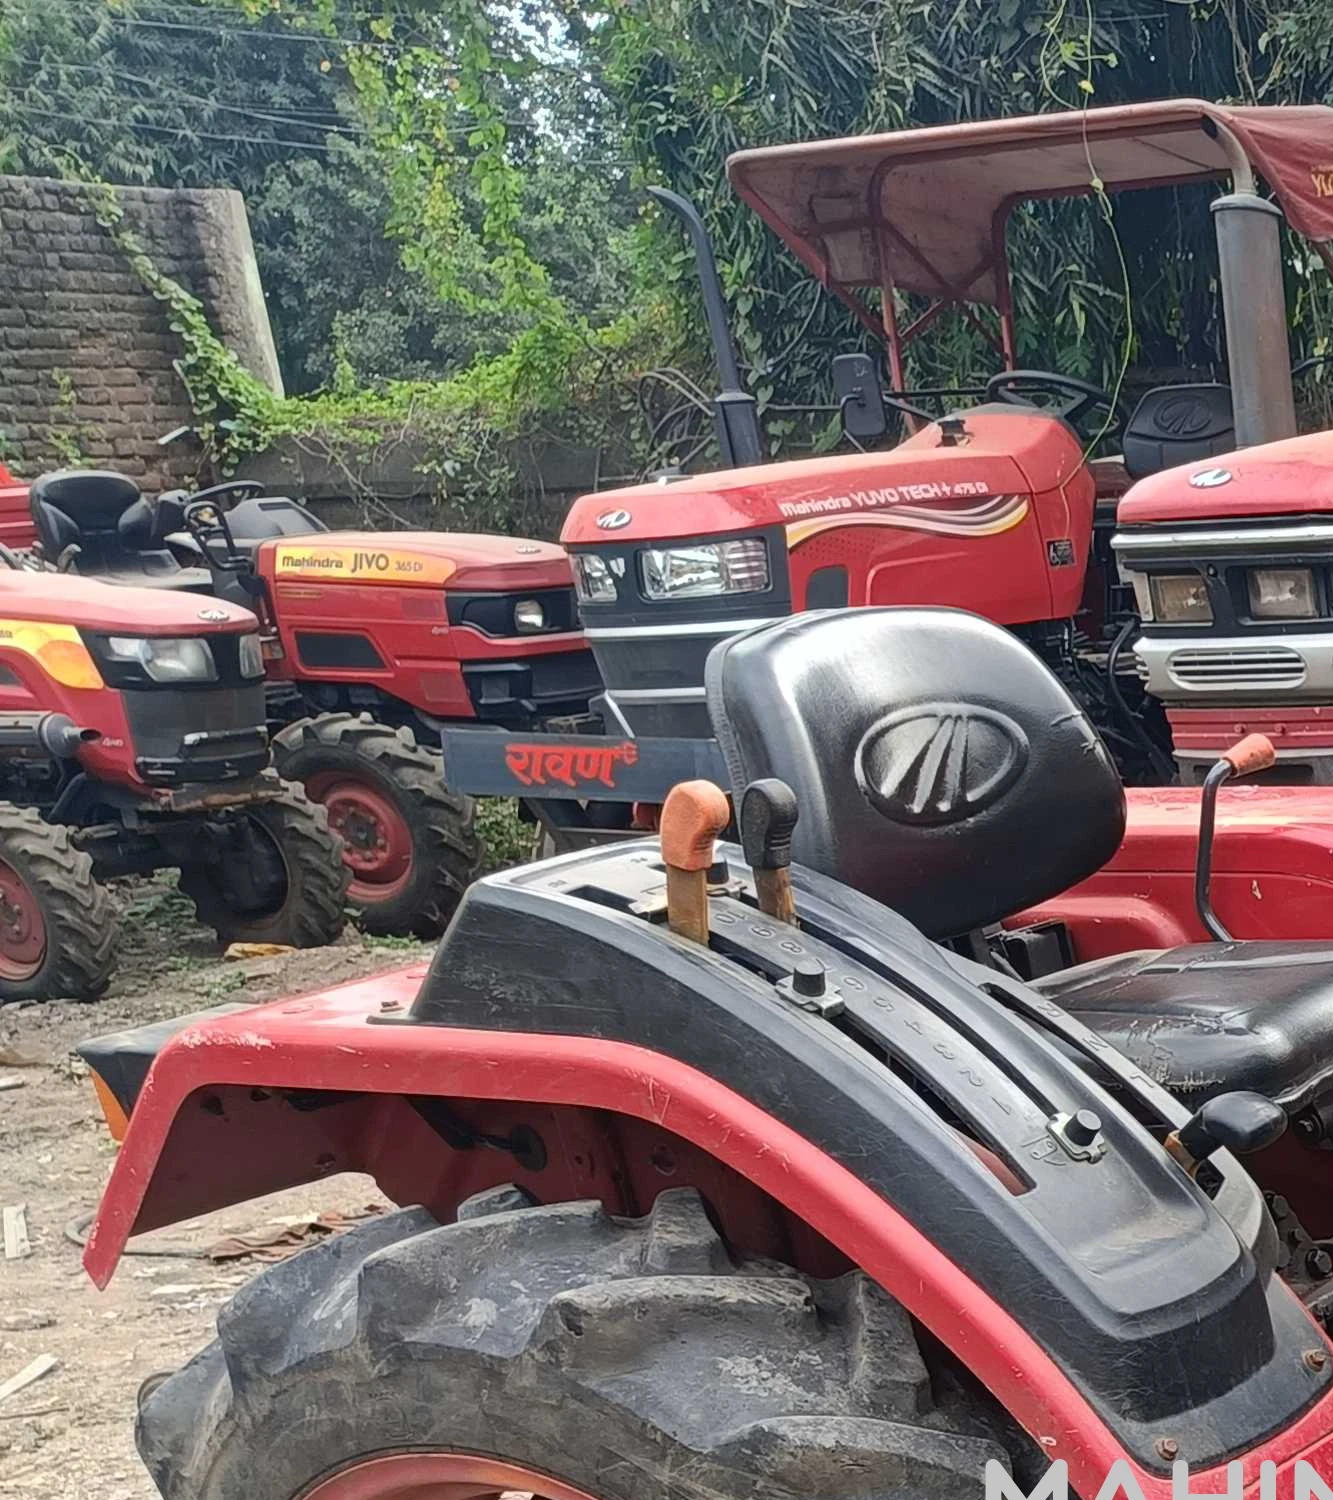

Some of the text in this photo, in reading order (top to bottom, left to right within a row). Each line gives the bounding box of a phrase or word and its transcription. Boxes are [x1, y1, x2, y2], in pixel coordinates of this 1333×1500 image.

[779, 495, 851, 517] Mahindra
[850, 487, 899, 506] YUVO
[282, 553, 423, 574] Mahindra JIVO 365 DI
[932, 1043, 955, 1060] 3
[959, 1068, 985, 1087] 2
